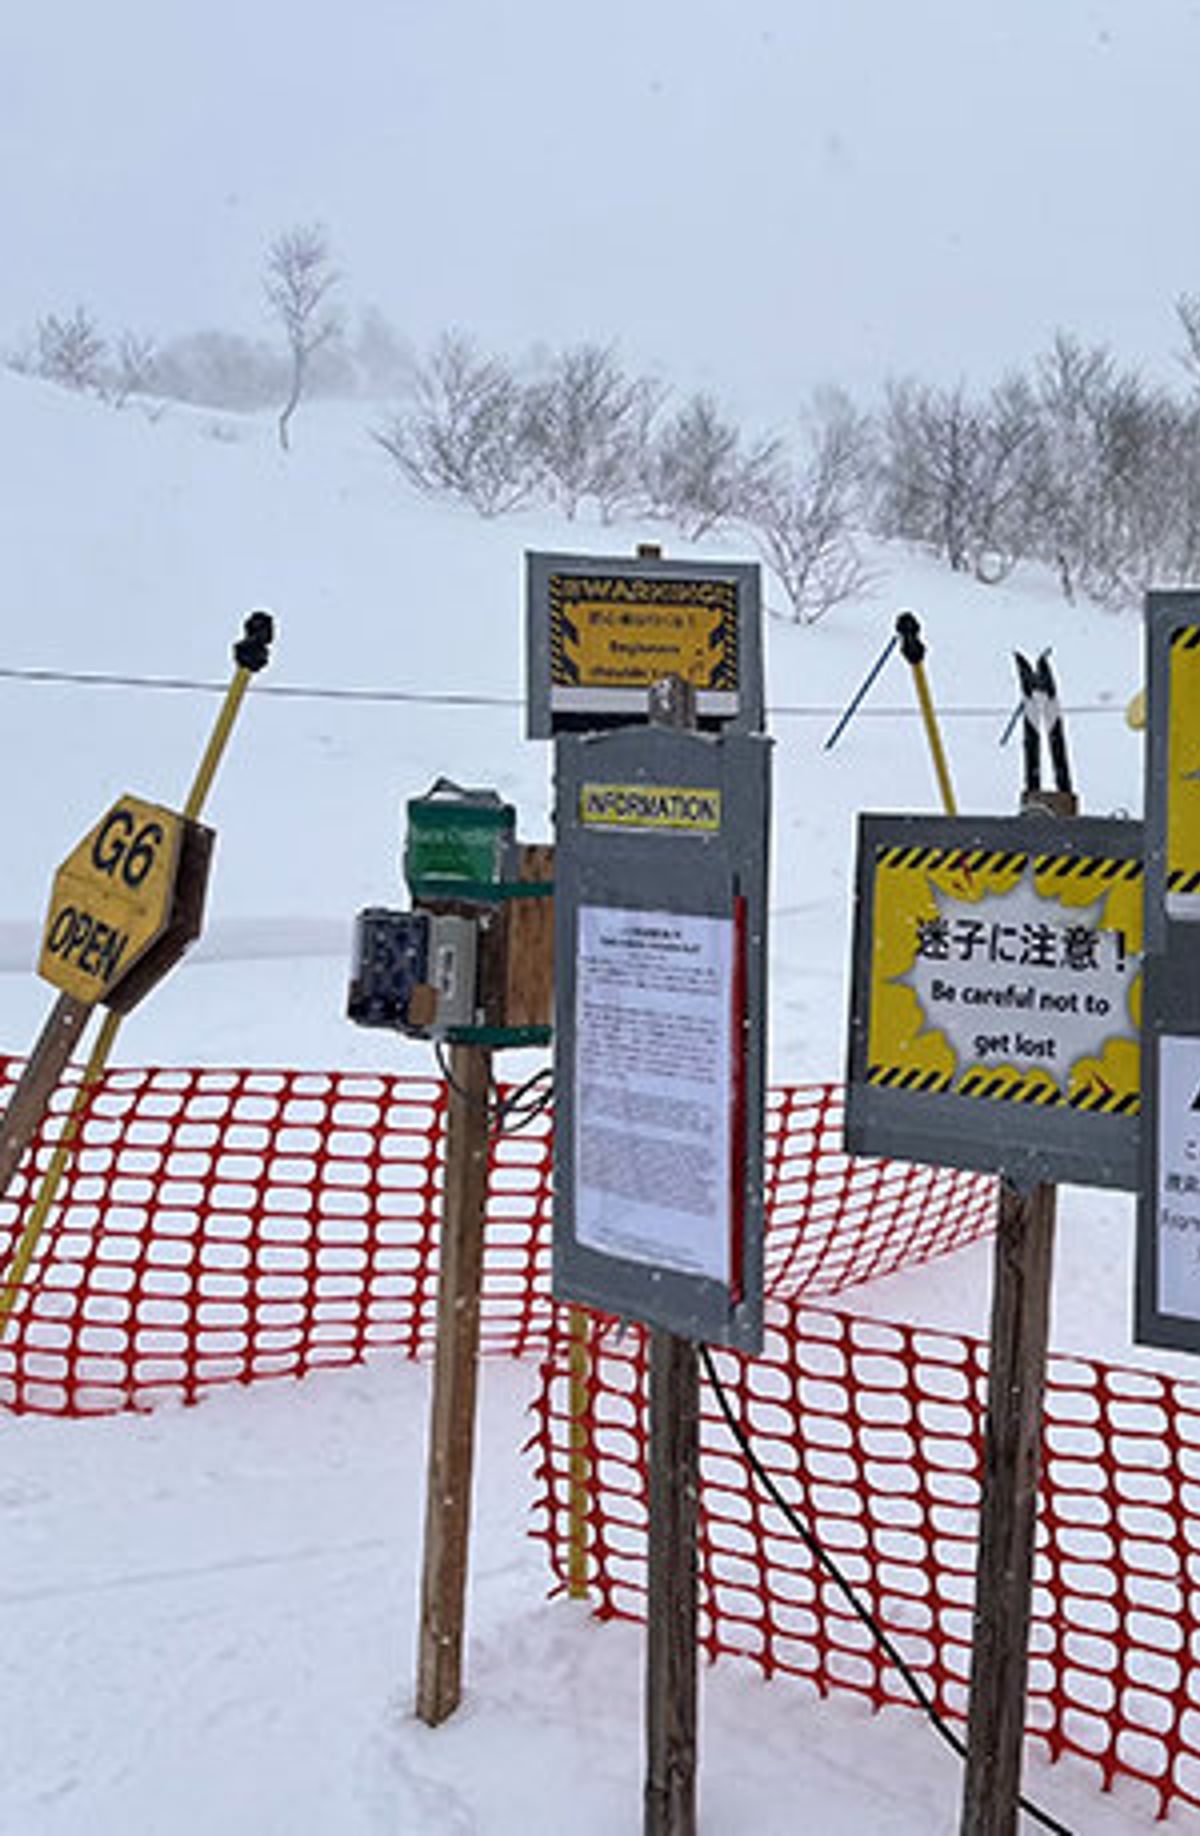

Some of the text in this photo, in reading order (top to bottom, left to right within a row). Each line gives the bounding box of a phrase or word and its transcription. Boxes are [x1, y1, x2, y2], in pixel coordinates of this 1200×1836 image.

[584, 791, 717, 821] INFORMATION
[91, 808, 165, 890] G6
[48, 905, 129, 984] OPEN
[931, 979, 1111, 1016] Be careful not to
[973, 1032, 1057, 1059] get lost
